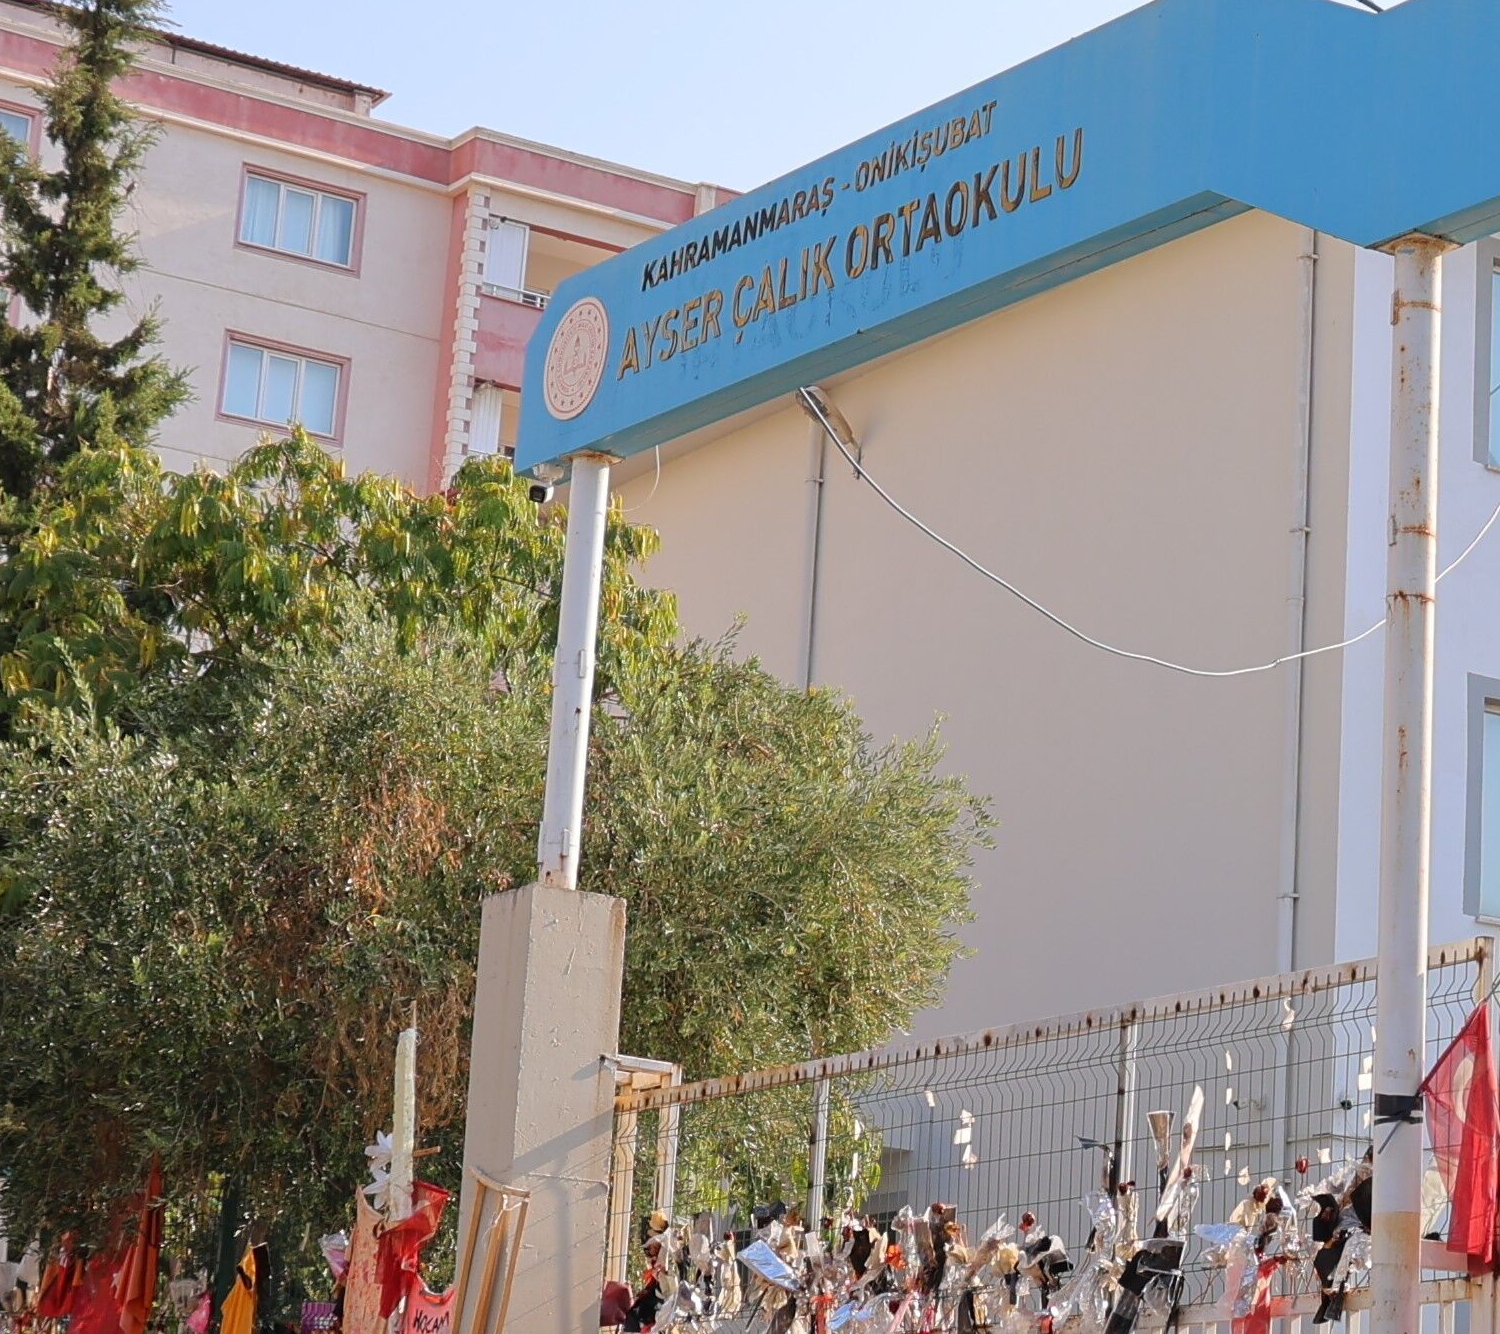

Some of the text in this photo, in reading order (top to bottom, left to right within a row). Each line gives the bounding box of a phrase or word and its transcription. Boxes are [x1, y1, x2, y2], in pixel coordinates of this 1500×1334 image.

[616, 289, 723, 381] AYSER
[732, 235, 837, 345] ÇALIK
[845, 127, 1084, 279] ORTAOKULU
[641, 176, 836, 292] KAHRAMANMARAŞ
[855, 100, 997, 193] ONİKİŞUBAT
